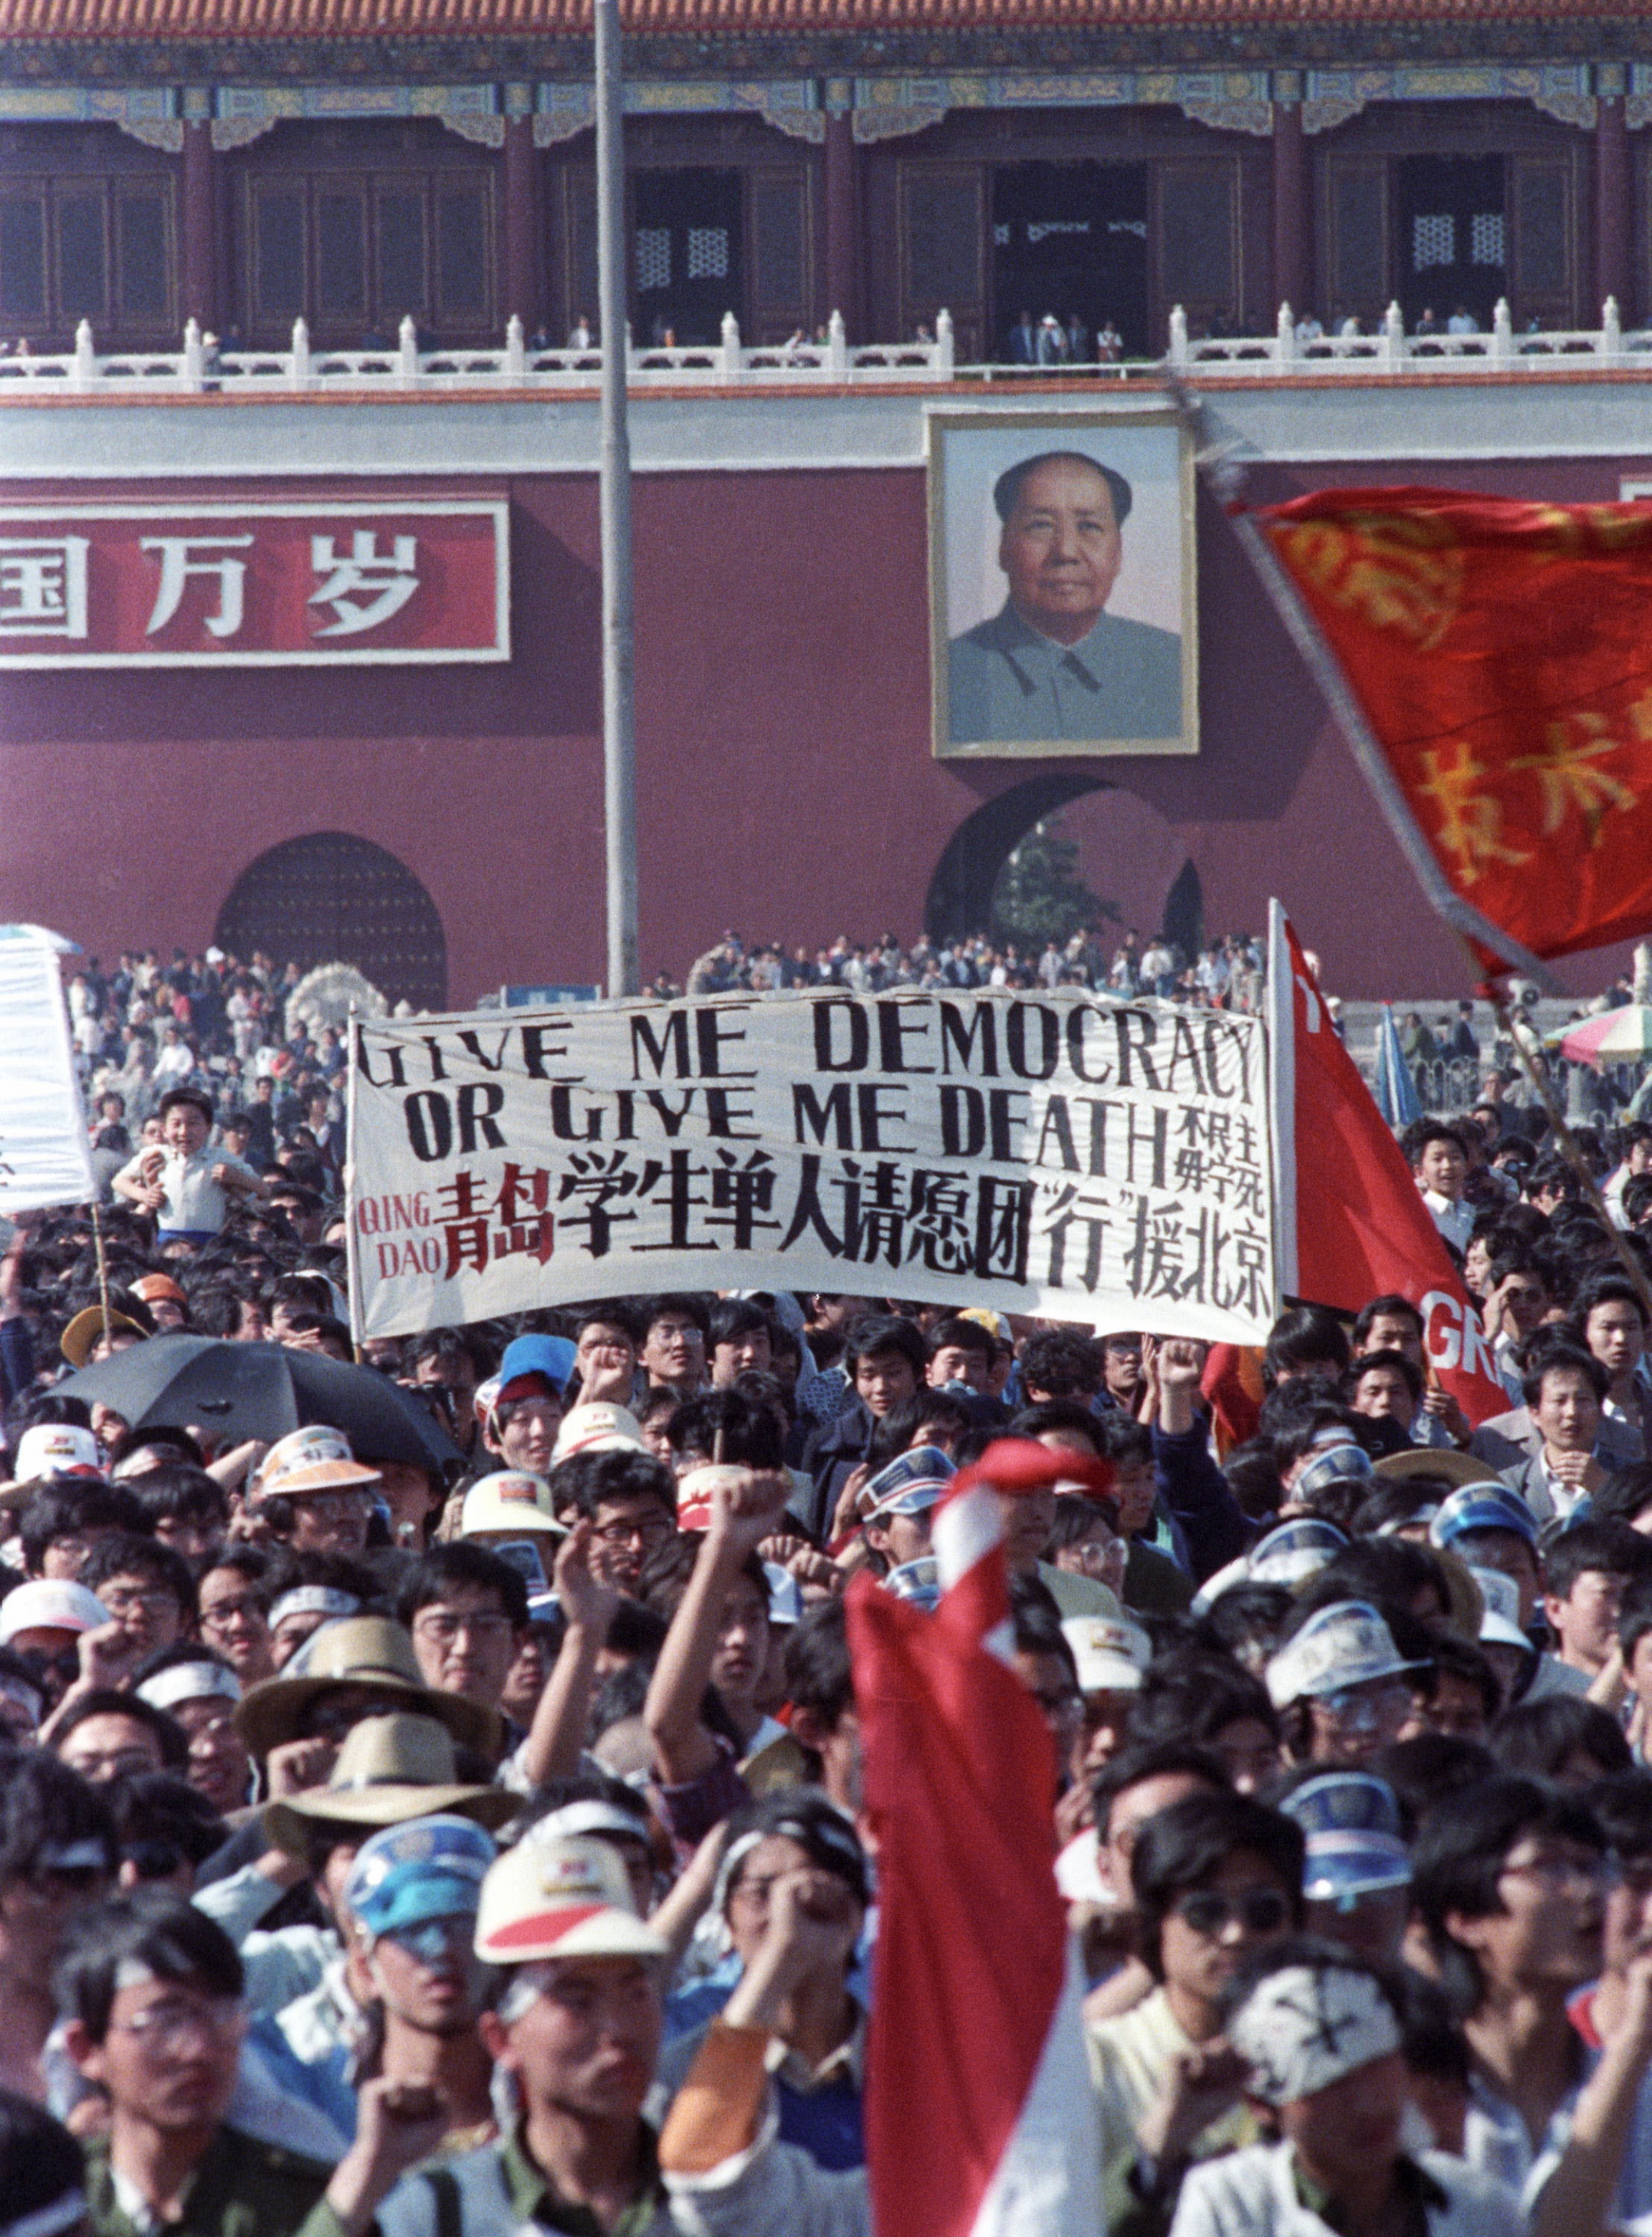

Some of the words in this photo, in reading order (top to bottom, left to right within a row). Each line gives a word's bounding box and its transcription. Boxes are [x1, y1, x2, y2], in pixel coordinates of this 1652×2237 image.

[0, 530, 420, 638] 国万岁
[356, 1021, 585, 1089] GIVE
[631, 1005, 758, 1081] ME
[812, 999, 1255, 1105] DEMOCRACY
[404, 1082, 506, 1163] OR
[550, 1085, 762, 1143] GIVE
[792, 1082, 917, 1154] ME
[937, 1083, 1168, 1191] DEATH
[358, 1191, 430, 1235] QING
[377, 1237, 442, 1280] DAO
